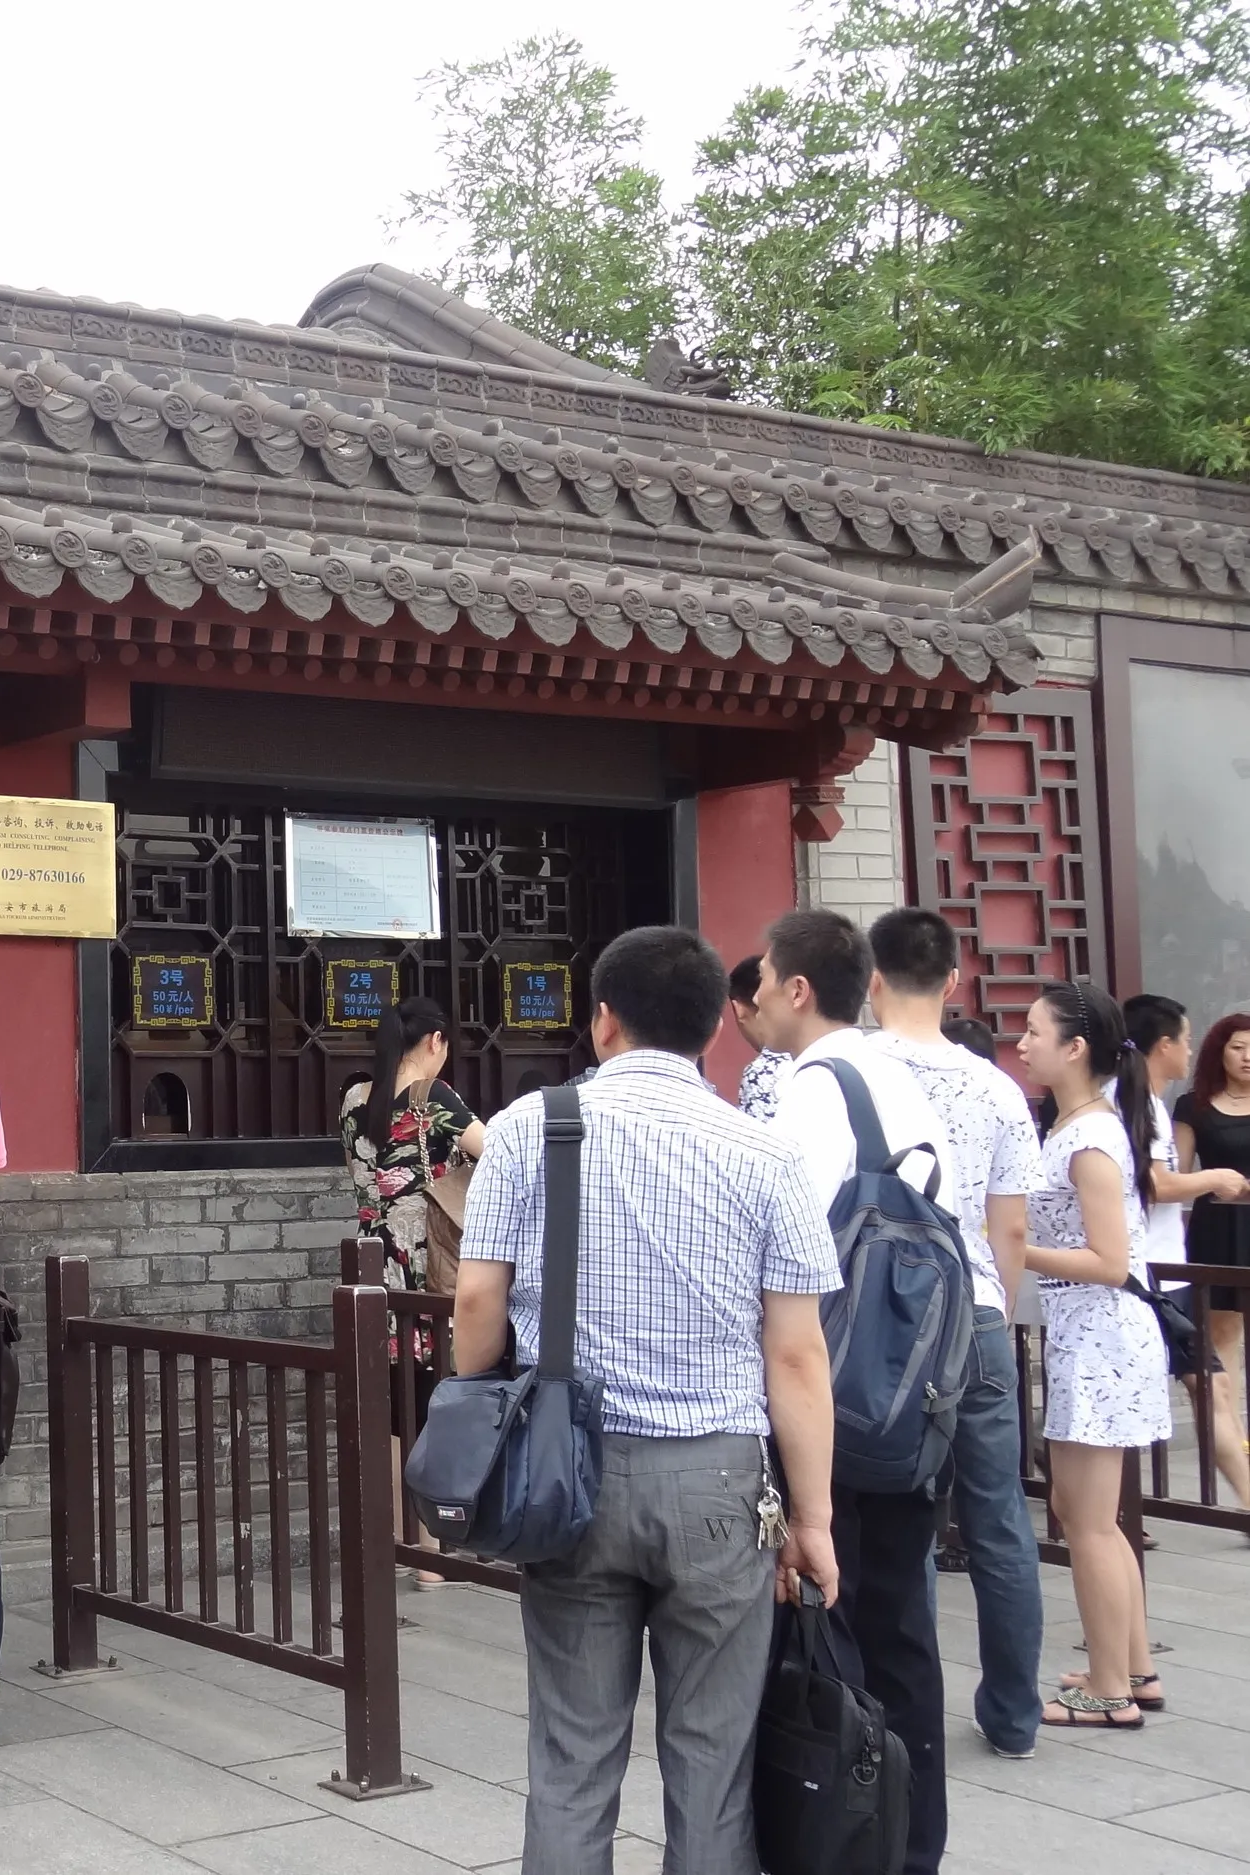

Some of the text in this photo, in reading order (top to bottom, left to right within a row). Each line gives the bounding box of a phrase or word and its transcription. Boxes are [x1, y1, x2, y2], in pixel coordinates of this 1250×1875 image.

[3, 842, 31, 850] HELPING
[33, 844, 70, 852] TELEPHONE
[1, 867, 86, 884] 029-87630166
[159, 969, 184, 987] 3号
[349, 972, 373, 989] 2号
[526, 975, 547, 992] 1号
[703, 1516, 738, 1542] W
